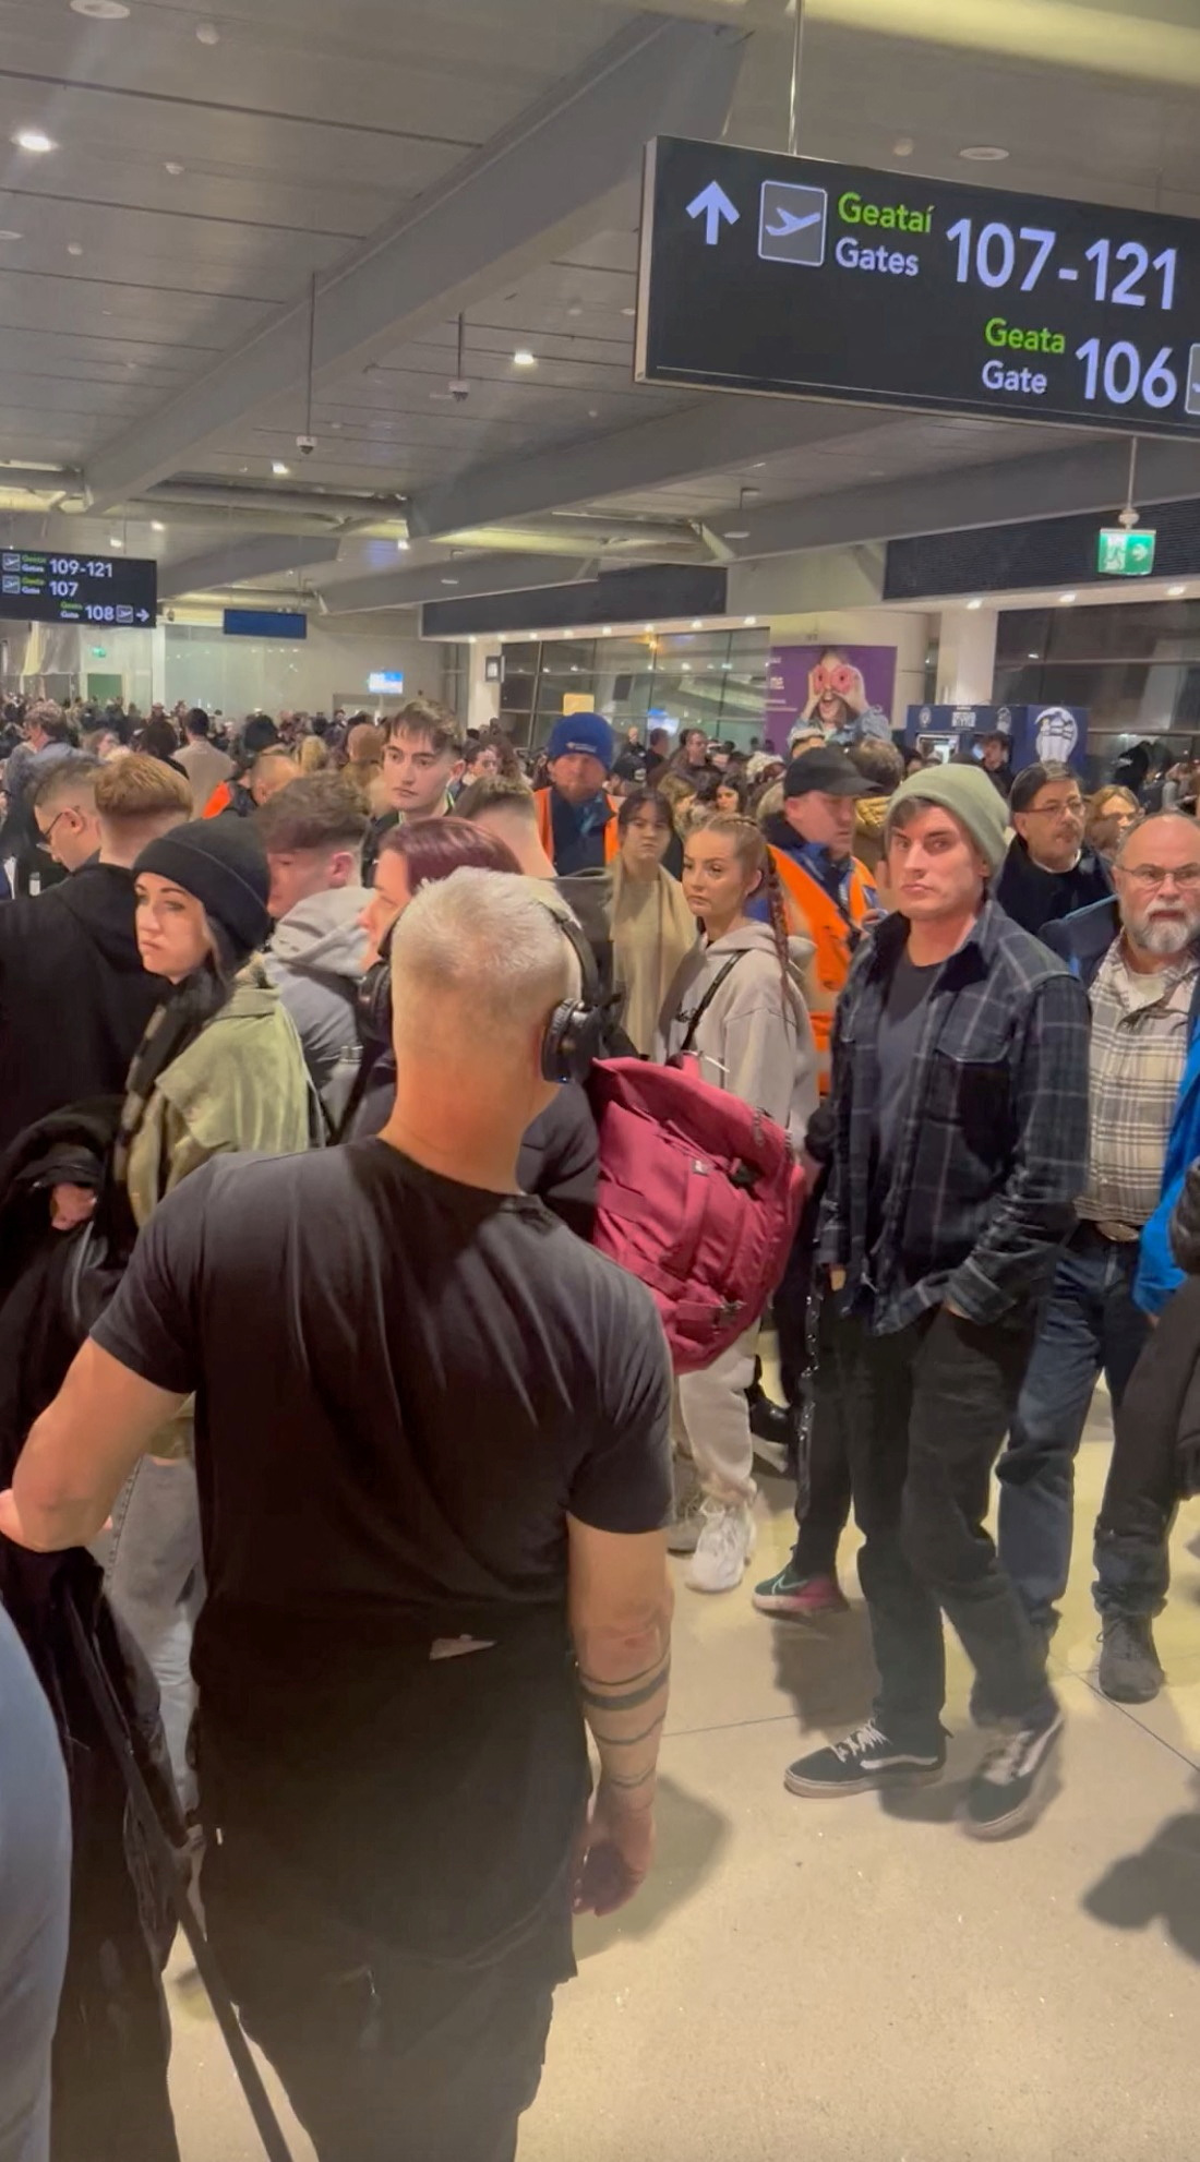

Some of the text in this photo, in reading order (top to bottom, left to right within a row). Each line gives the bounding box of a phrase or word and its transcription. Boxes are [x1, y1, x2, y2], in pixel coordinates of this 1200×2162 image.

[837, 191, 935, 234] Geataí
[835, 236, 919, 278] Gates
[945, 217, 1177, 310] 107-121
[983, 317, 1065, 354] Geata
[981, 359, 1048, 395] Gate
[1075, 337, 1178, 409] 106
[49, 559, 113, 578] 109-121
[49, 580, 79, 598] 107
[85, 604, 115, 621] 108
